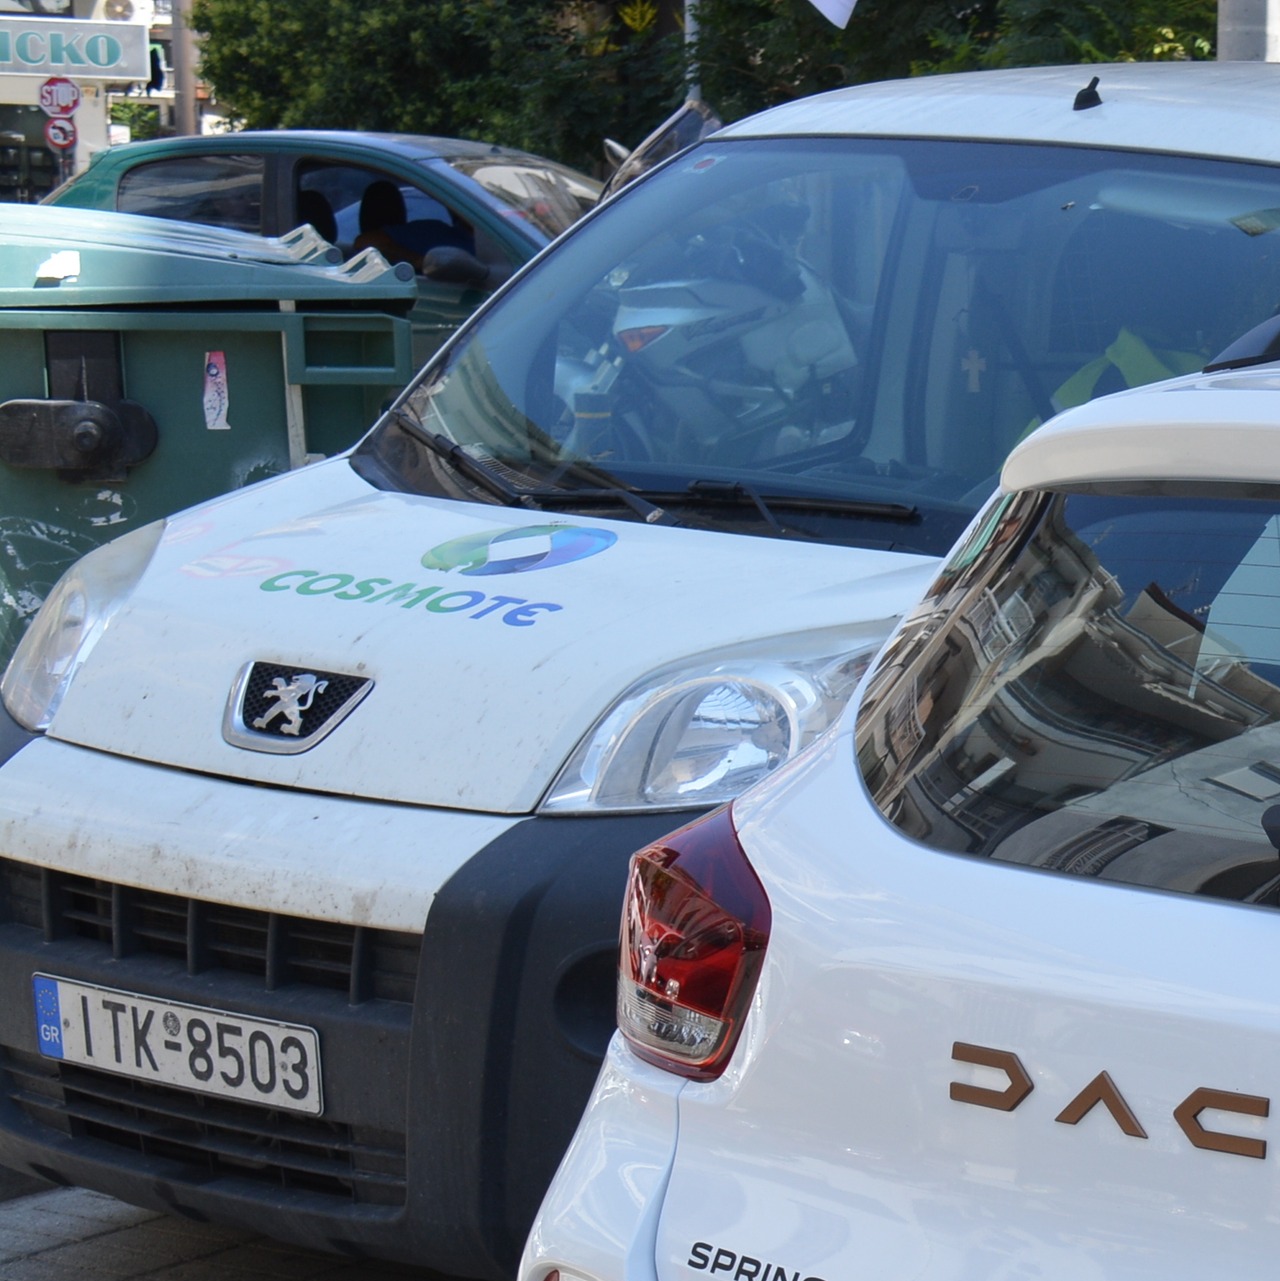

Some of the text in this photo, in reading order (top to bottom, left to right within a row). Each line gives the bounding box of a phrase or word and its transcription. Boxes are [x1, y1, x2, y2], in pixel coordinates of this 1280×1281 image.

[42, 85, 78, 107] STP
[259, 570, 563, 627] COSMOTE
[41, 1024, 60, 1044] GR
